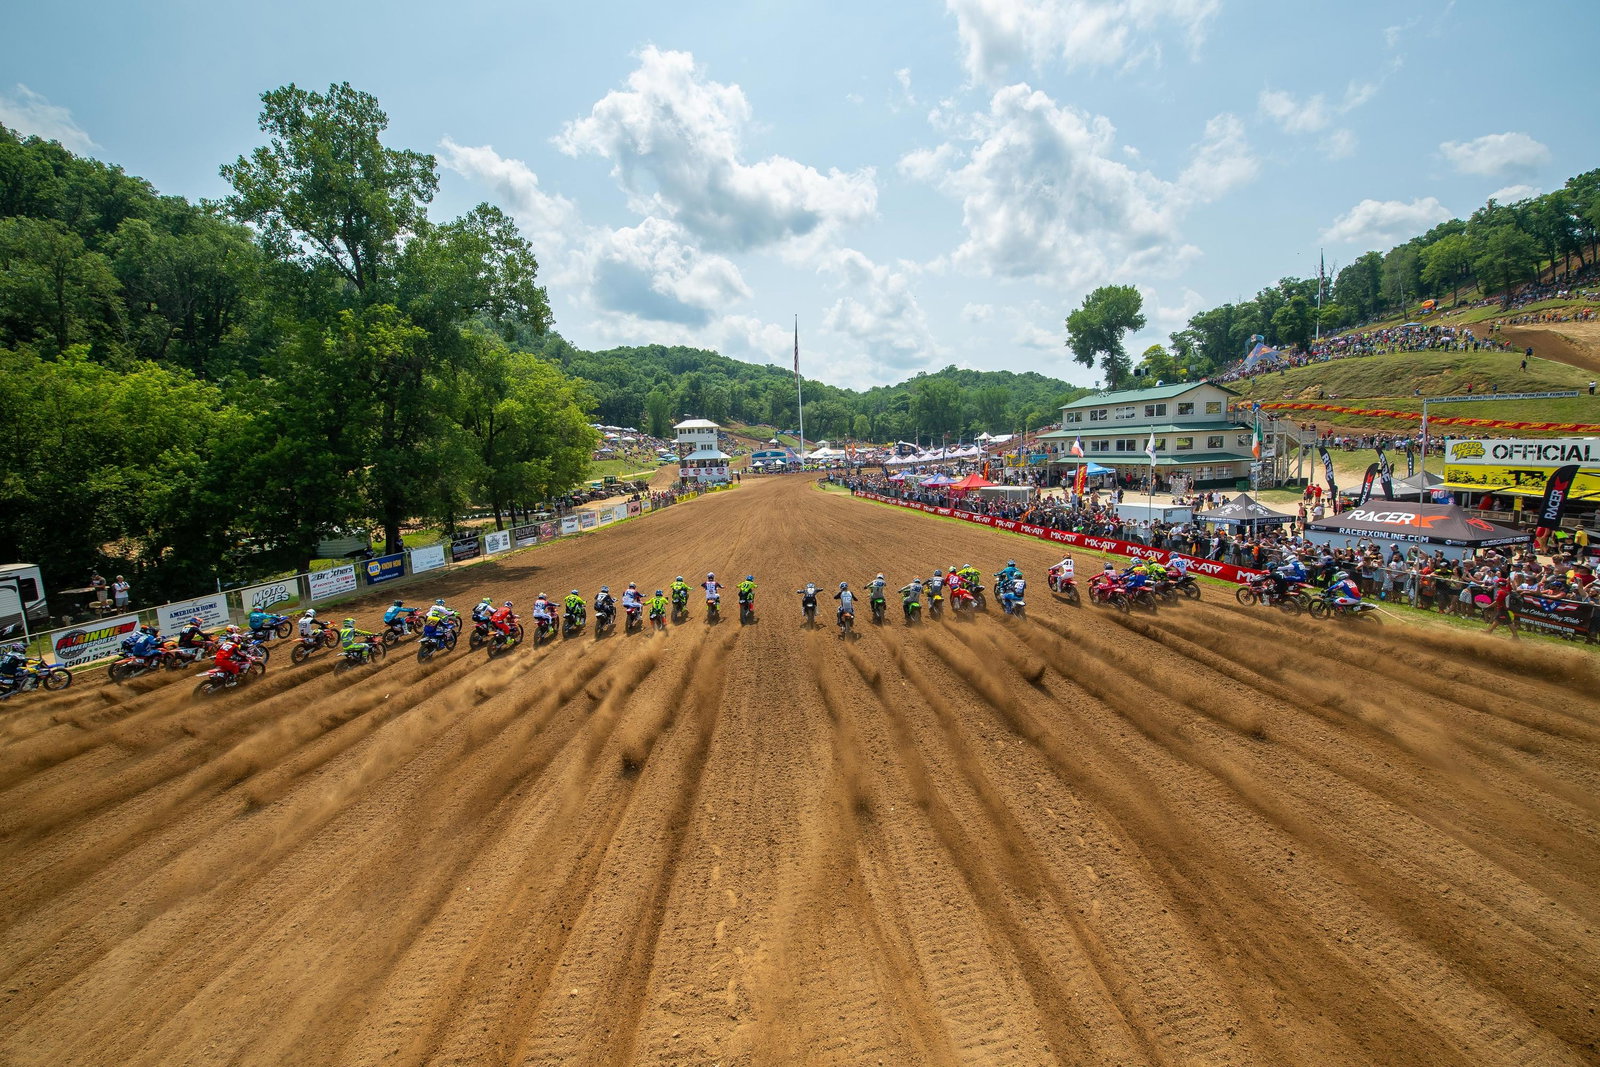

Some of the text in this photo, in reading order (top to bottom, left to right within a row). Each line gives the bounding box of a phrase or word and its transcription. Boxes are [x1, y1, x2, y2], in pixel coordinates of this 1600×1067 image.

[1452, 442, 1481, 451] MOTO
[1457, 448, 1485, 459] TEES
[1492, 444, 1590, 462] OFFICIAL
[1544, 489, 1564, 520] RACER
[1347, 509, 1415, 525] RACER
[1020, 524, 1044, 535] MX-ATV
[1050, 531, 1077, 542] MX-ATV
[1084, 538, 1117, 549] MX-ATV
[1126, 545, 1164, 560] MX-ATV
[252, 584, 286, 607] MOTO
[260, 592, 291, 609] TEES
[169, 606, 200, 619] AMERICAN
[60, 636, 117, 654] POWERSPORTS
